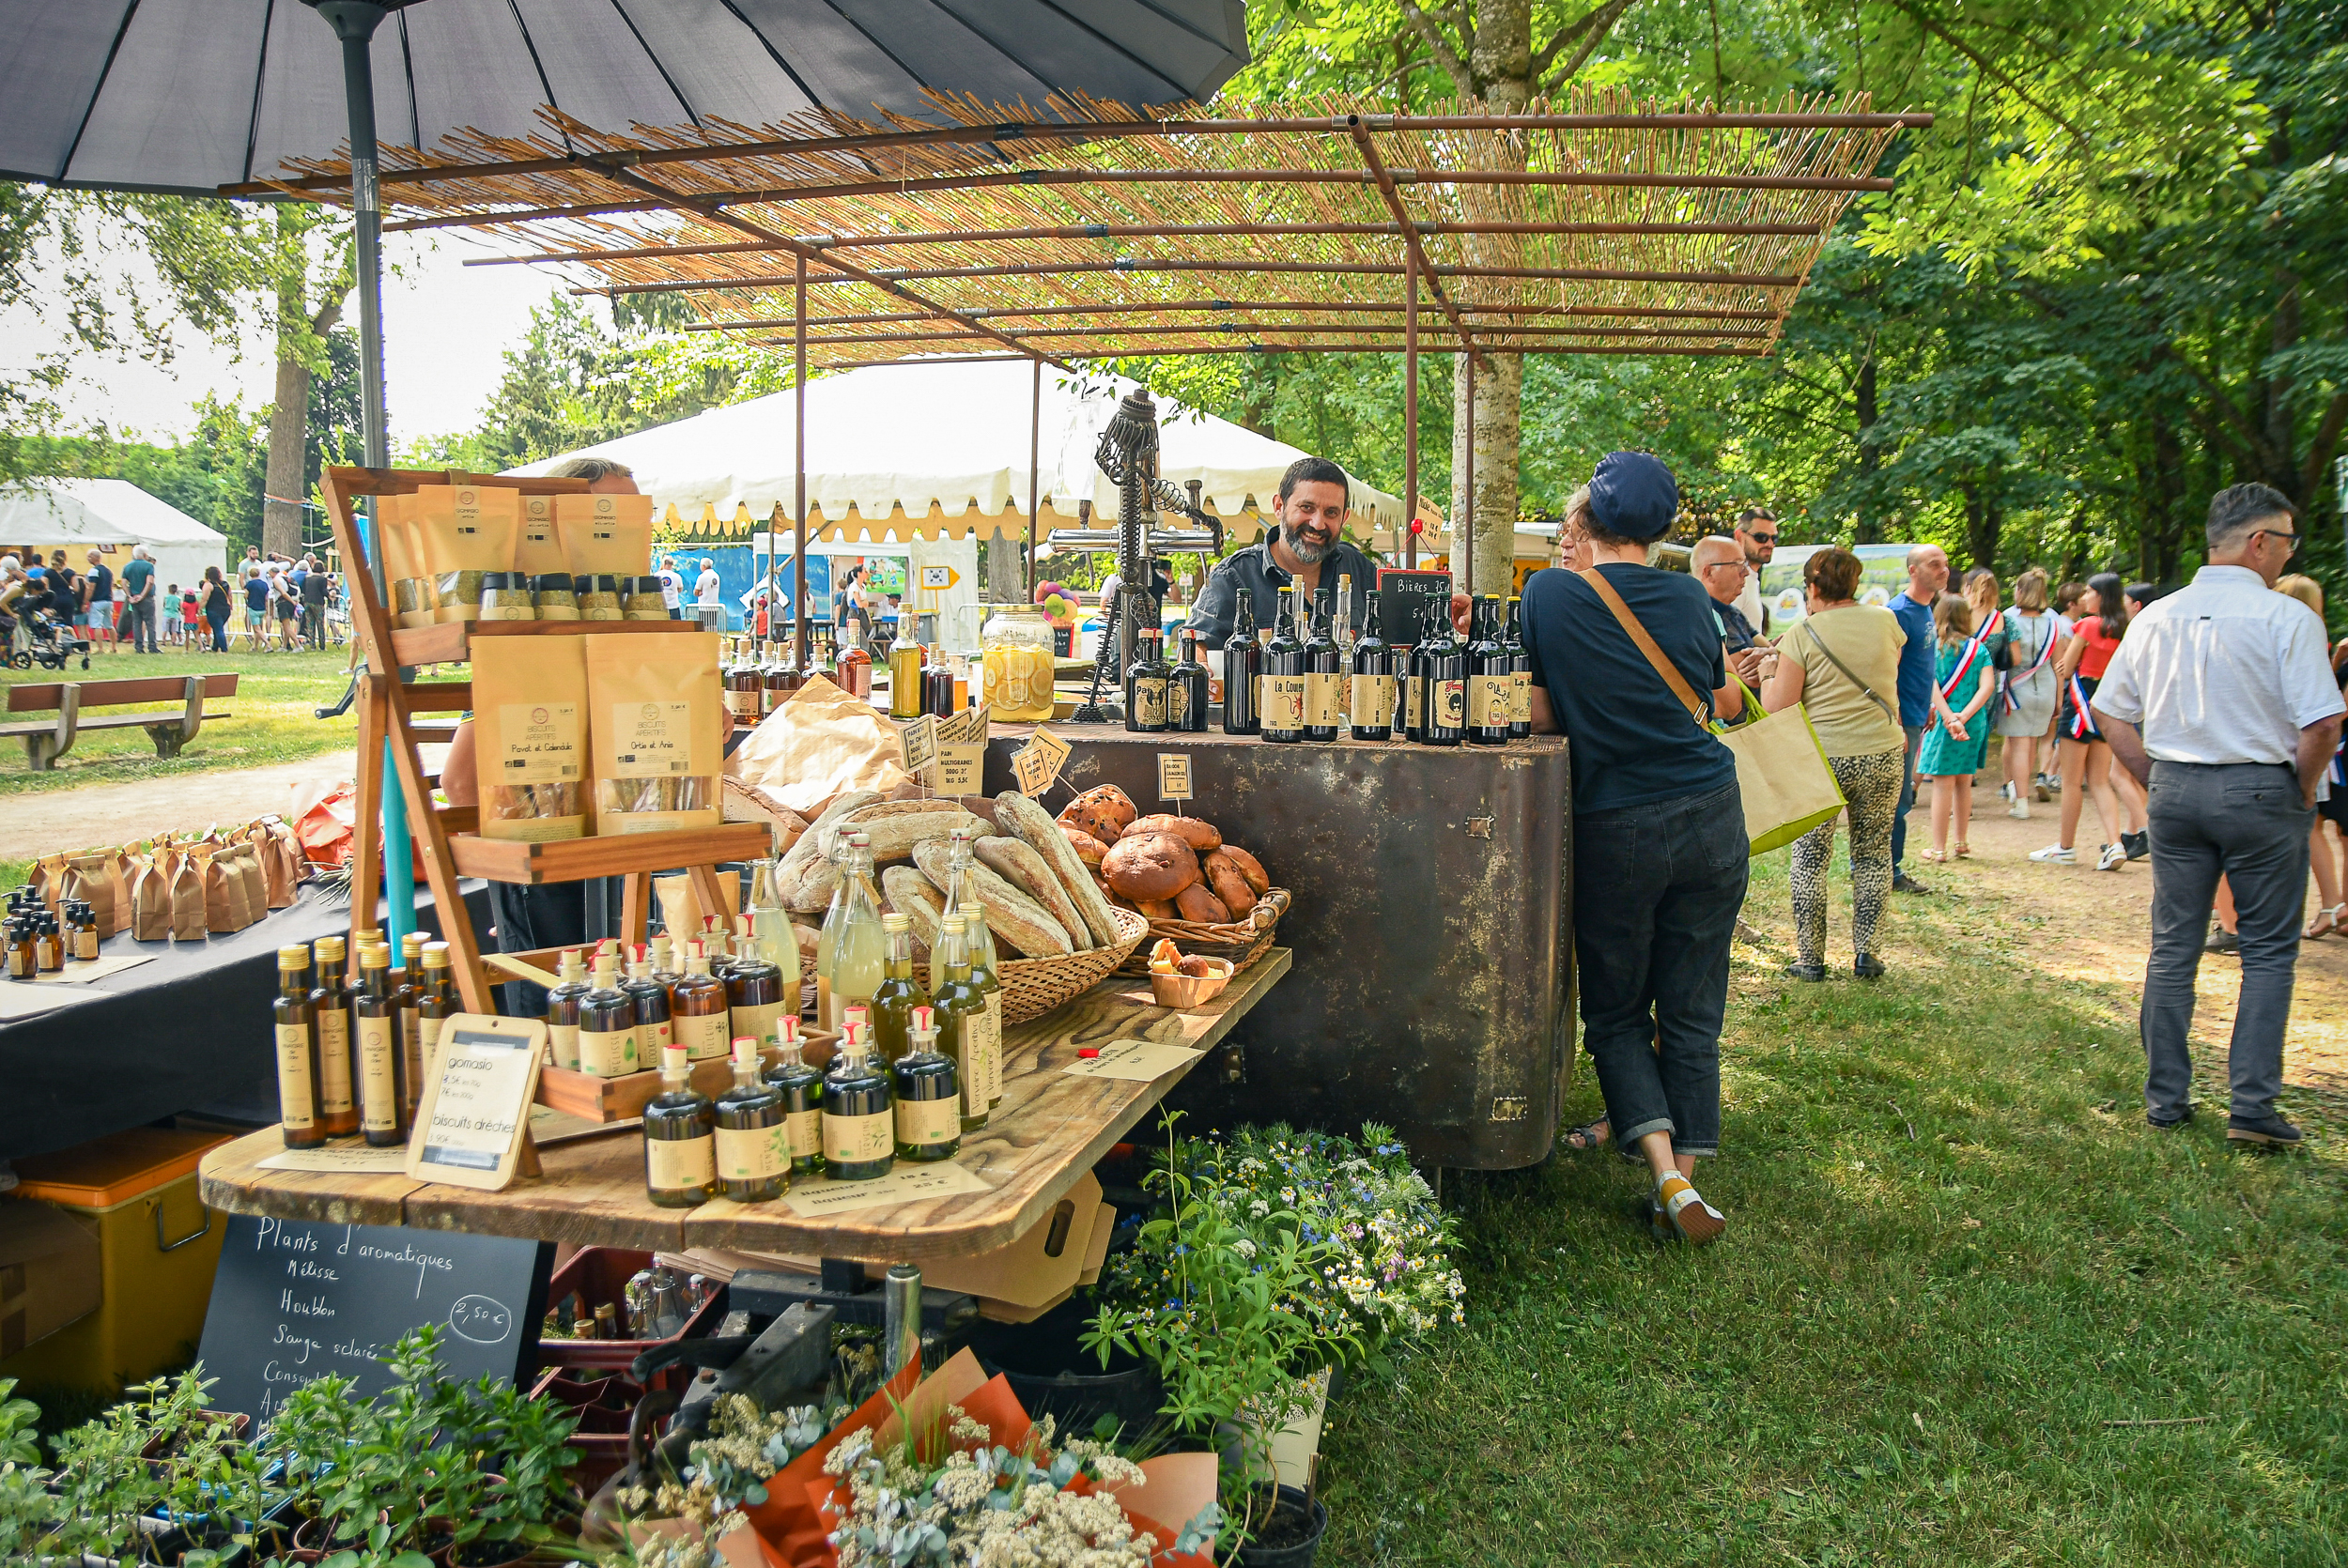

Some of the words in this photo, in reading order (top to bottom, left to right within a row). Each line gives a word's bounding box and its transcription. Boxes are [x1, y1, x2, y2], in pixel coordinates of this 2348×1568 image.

[938, 726, 950, 736] PAIN
[545, 742, 572, 751] Calendula
[631, 741, 646, 749] Ortie
[648, 1025, 657, 1065] COQUELICOT
[706, 1021, 715, 1054] TILLEUL
[448, 1057, 493, 1070] gomasio
[971, 1069, 981, 1111] Verveine
[433, 1113, 471, 1130] biscuits
[862, 1119, 871, 1157] VERVEINE
[800, 1183, 857, 1197] liqueur
[811, 1191, 868, 1205] liqueur
[256, 1216, 318, 1251] Plants
[287, 1259, 340, 1280] Mélisse
[281, 1287, 335, 1316] Houblon
[273, 1324, 322, 1364] Sauge
